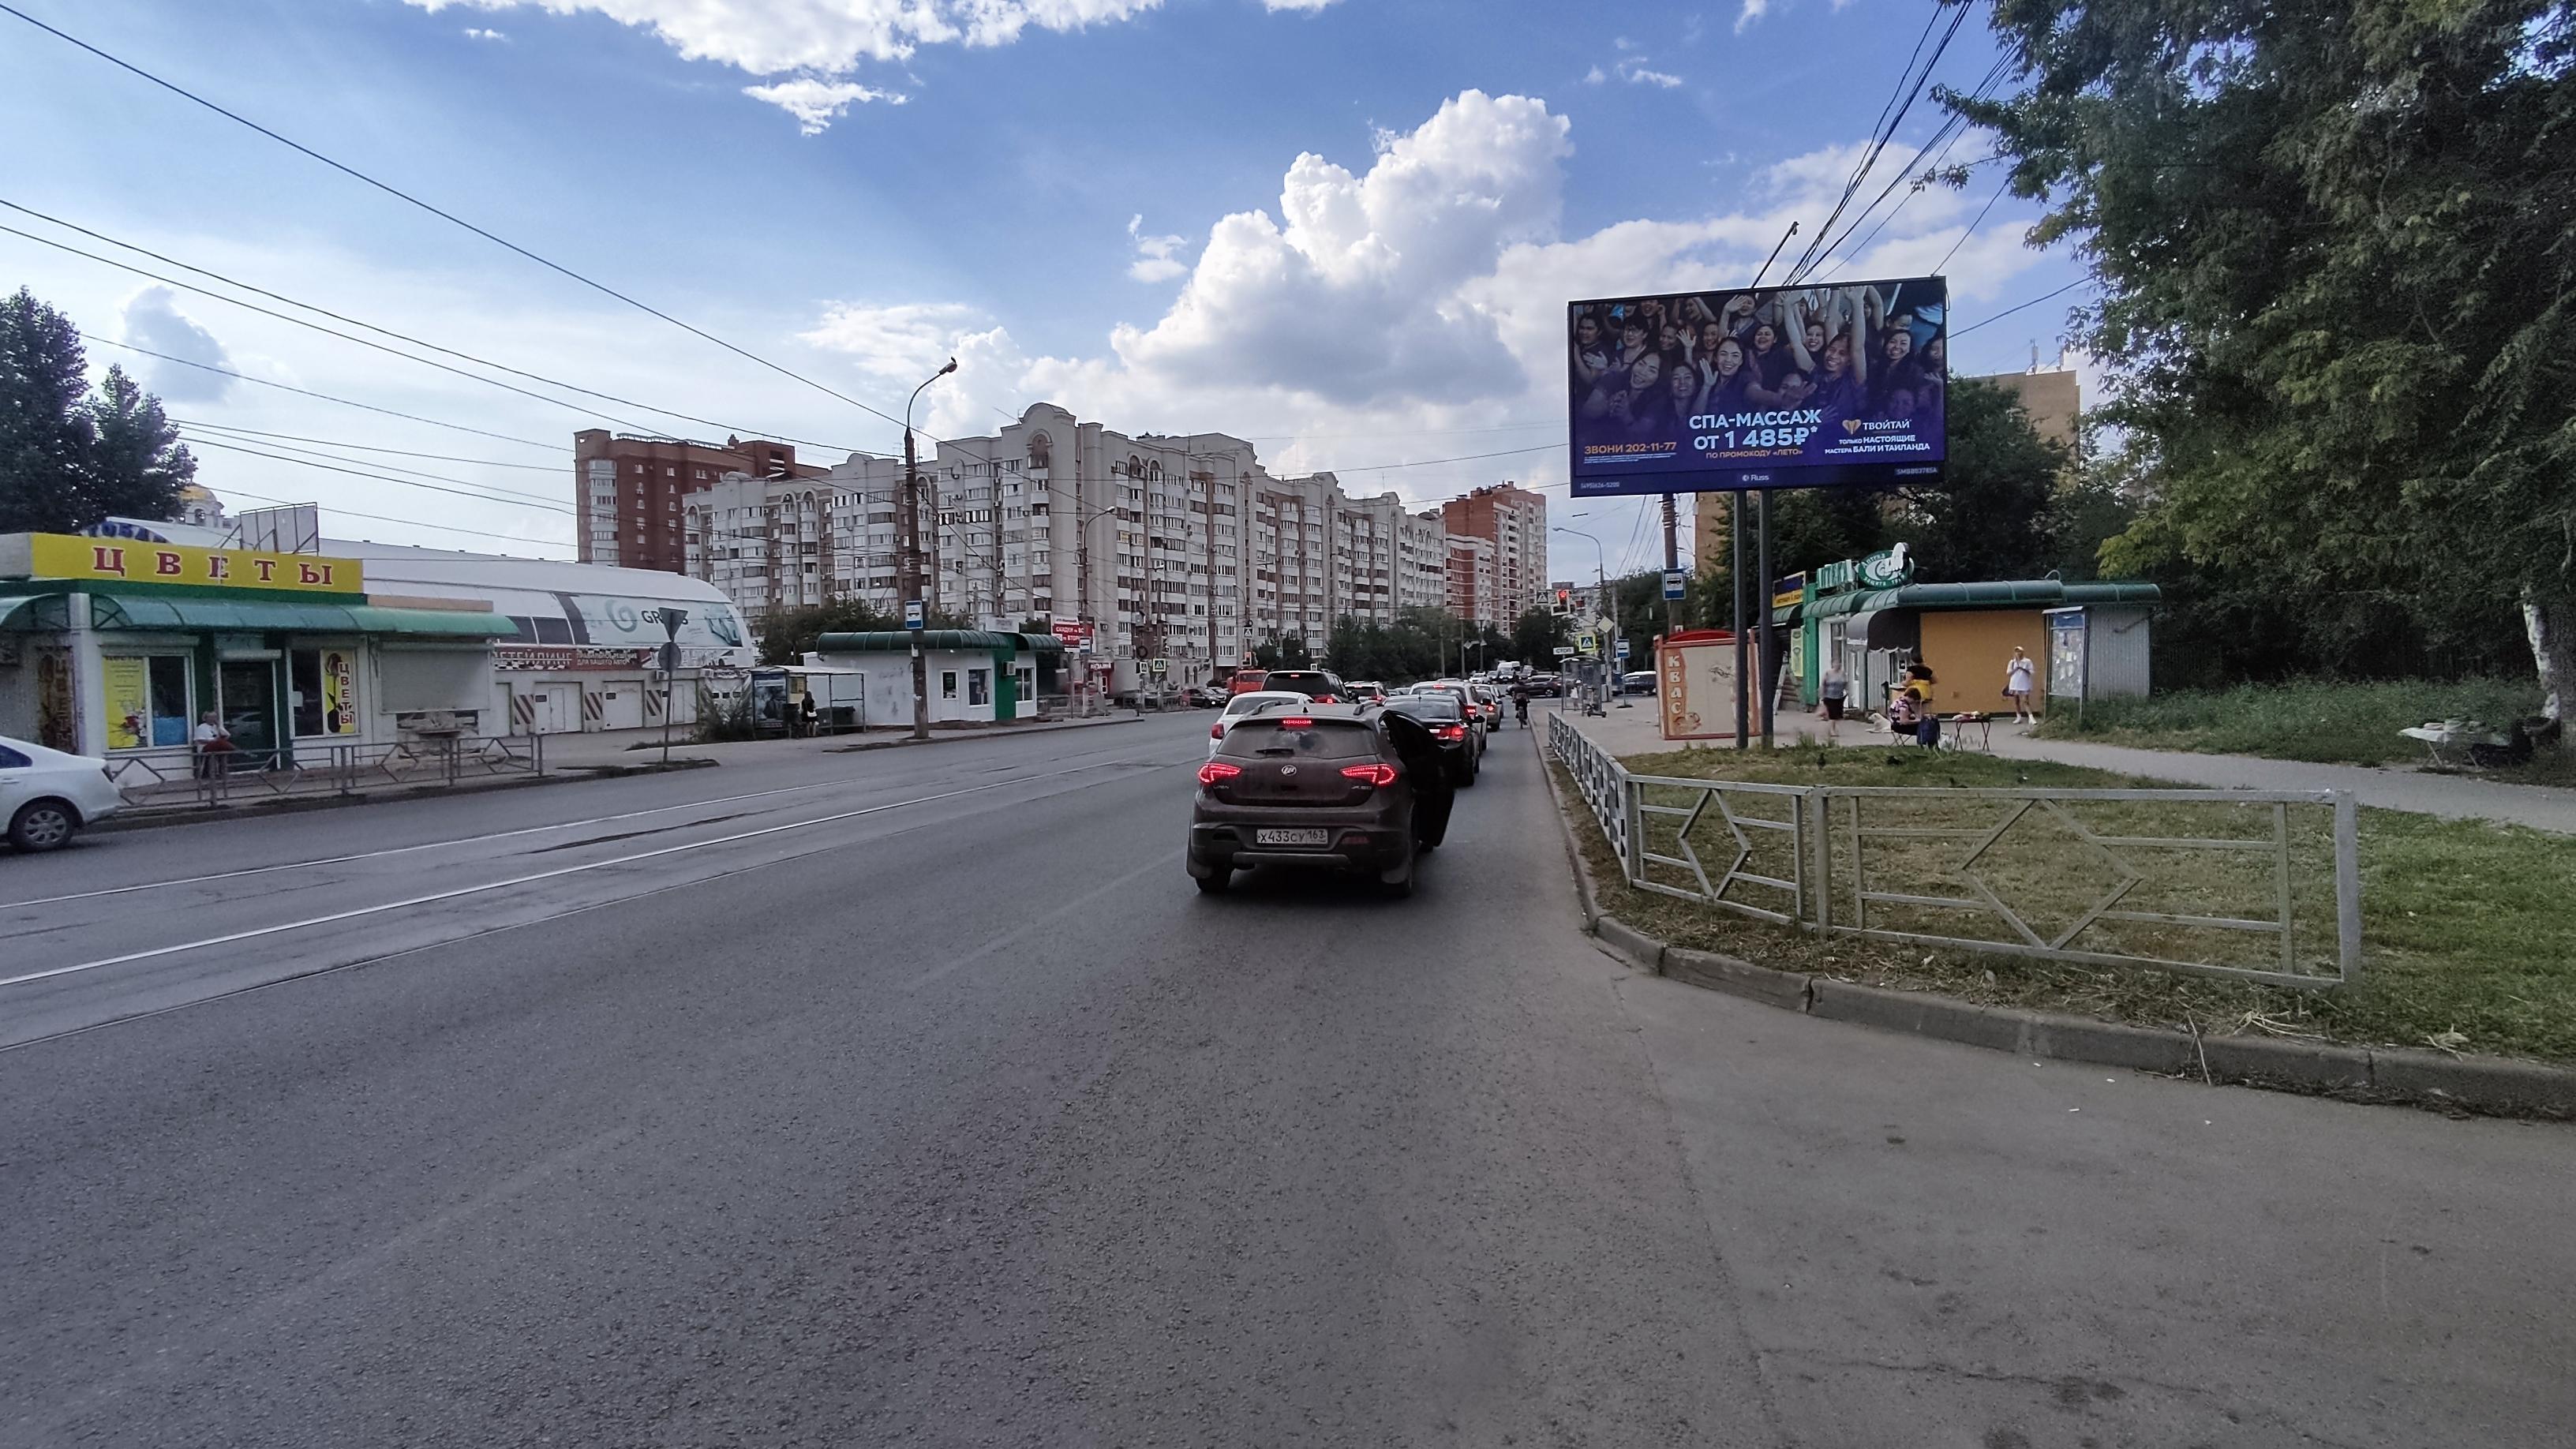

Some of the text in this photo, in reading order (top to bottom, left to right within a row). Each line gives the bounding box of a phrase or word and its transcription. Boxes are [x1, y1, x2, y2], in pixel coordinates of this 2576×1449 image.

[1689, 409, 1822, 429] СПА-МАССАЖ
[1694, 435, 1720, 450] ОТ
[1863, 435, 1916, 444] НАСТОЯЩИЕ
[1584, 442, 1677, 455] ЗВОНИ 202-11-77
[1719, 449, 1771, 459] ПРОМОКОДУ
[93, 546, 333, 585] ЦВЕТЫ
[1668, 655, 1683, 713] КВАС
[339, 663, 353, 724] ЦВЕТЫ
[1308, 829, 1326, 839] 163
